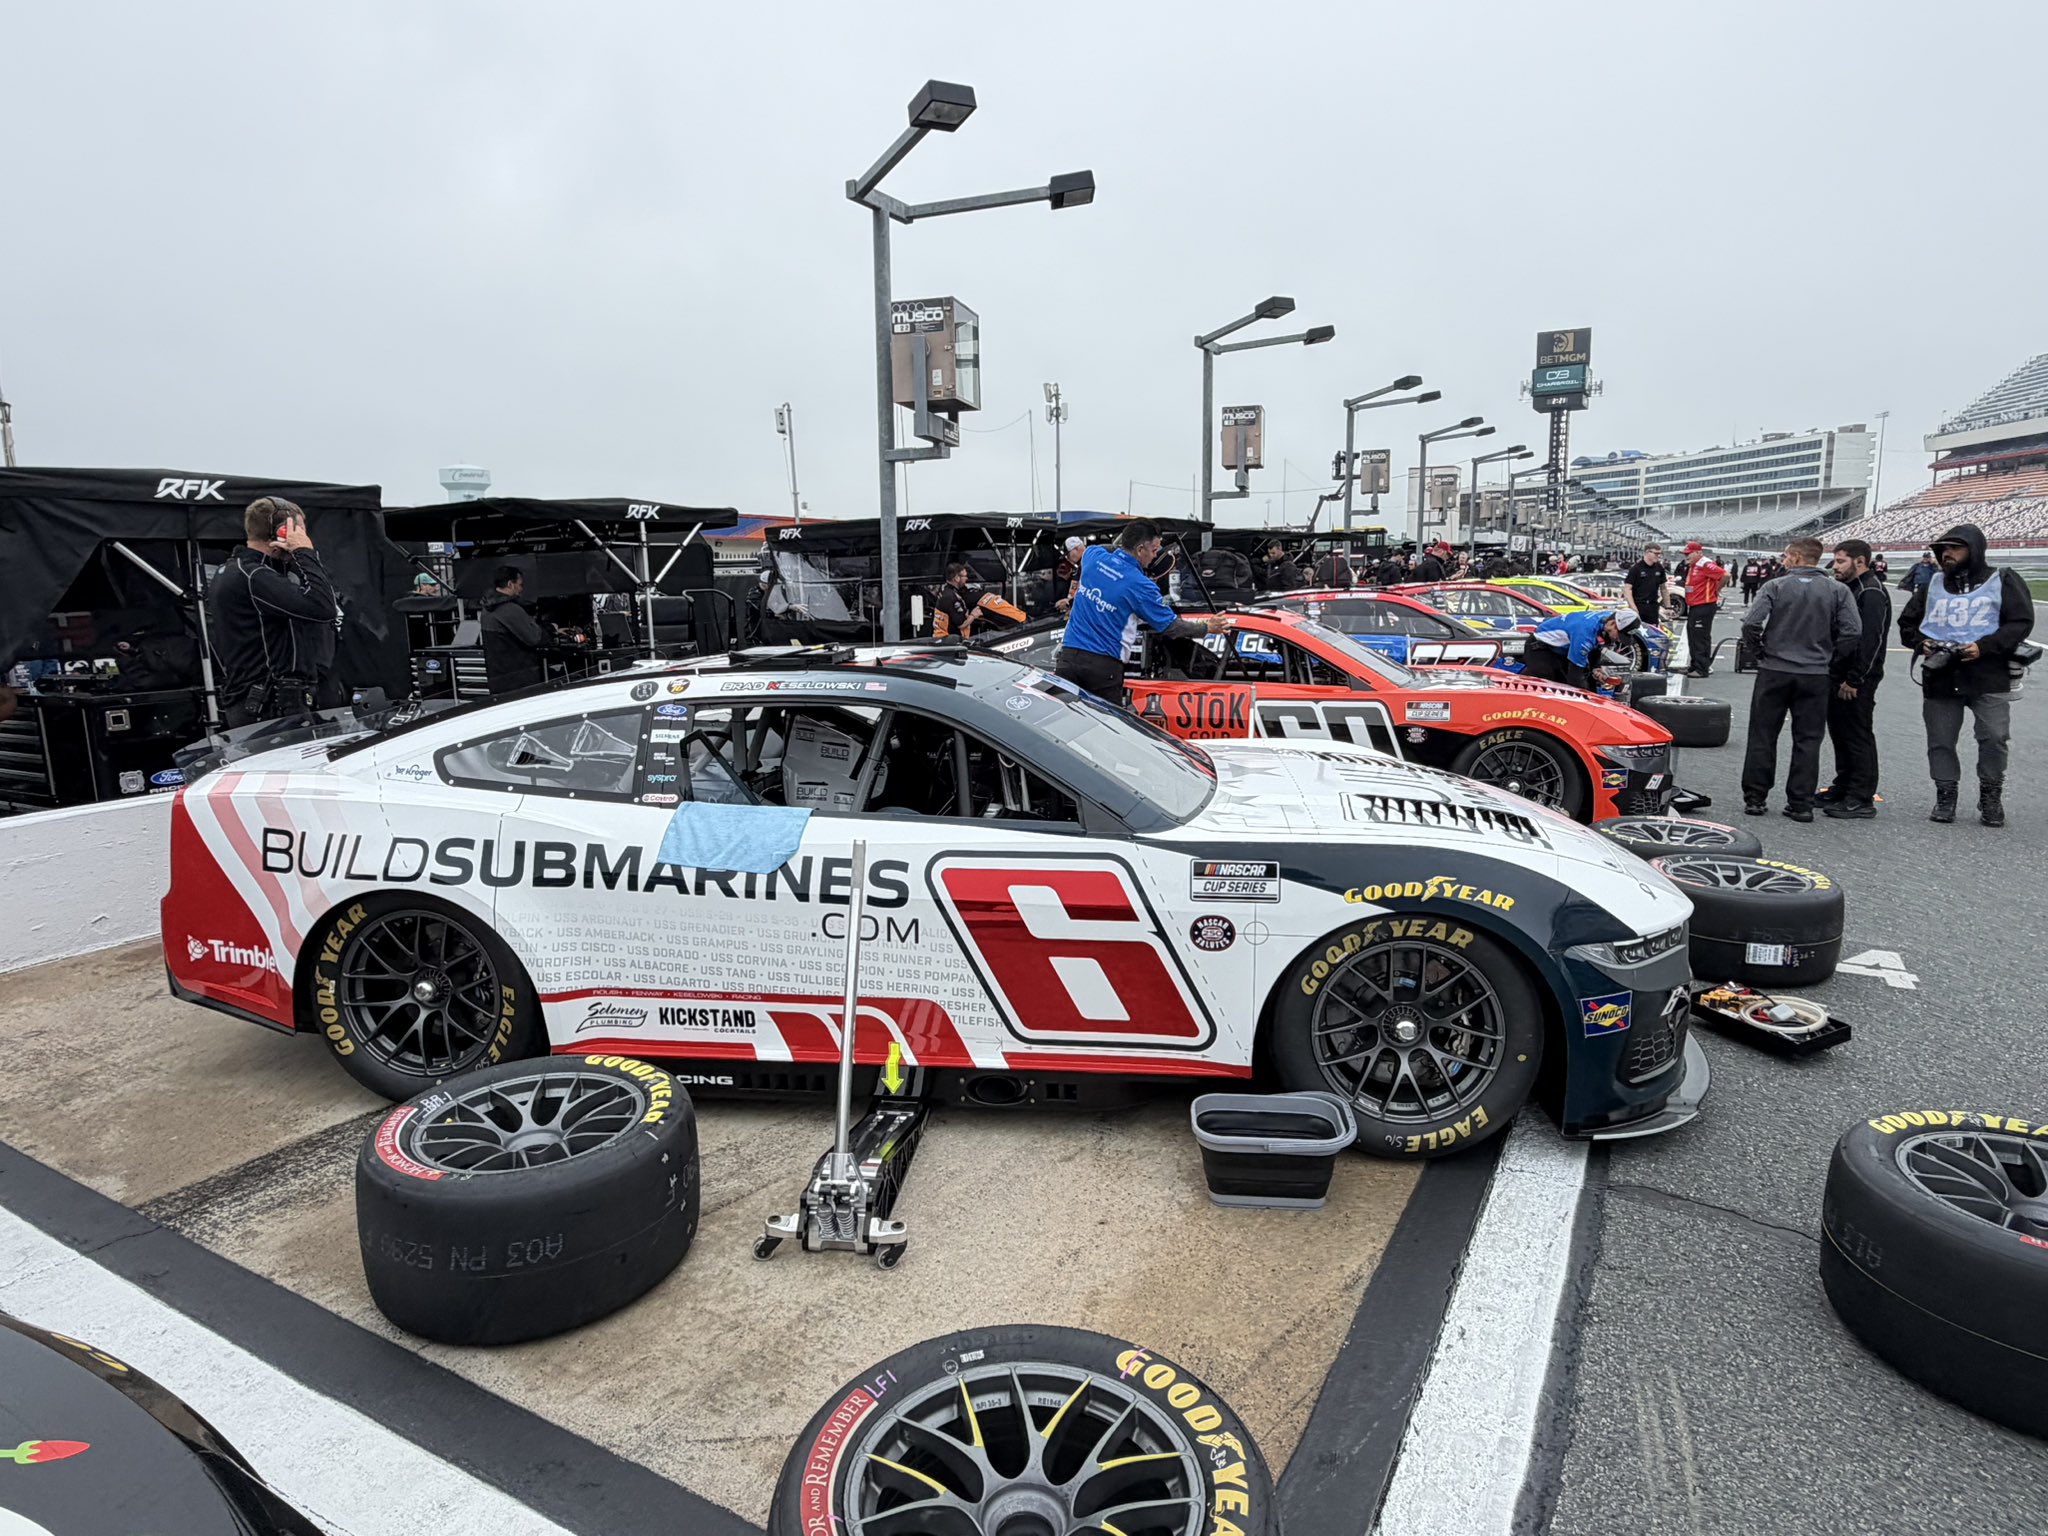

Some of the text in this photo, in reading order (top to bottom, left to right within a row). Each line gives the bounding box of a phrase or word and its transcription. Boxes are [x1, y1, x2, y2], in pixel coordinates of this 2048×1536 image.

[892, 310, 943, 323] musco
[1540, 353, 1586, 365] BETMGM
[154, 478, 226, 501] RFK
[625, 504, 660, 520] RFK
[1006, 517, 1023, 528] RFK
[779, 528, 802, 540] RFK
[904, 518, 933, 531] RFK
[1928, 598, 1990, 627] 432
[721, 680, 863, 692] BRAD KESELOWSKI
[1481, 707, 1567, 726] GOODYEAR
[1478, 730, 1524, 751] EAGLE
[405, 764, 432, 781] Kroger
[647, 774, 678, 784] syspro
[650, 795, 676, 803] Castrol
[262, 827, 909, 909] BUILDSUBMARINES
[1219, 864, 1266, 876] NASCAR
[1203, 881, 1267, 892] CUP SERIES
[1343, 876, 1516, 912] GOODYEAR
[746, 914, 768, 924] USS
[811, 912, 919, 945] .COM
[1197, 919, 1228, 930] NASCAR
[554, 913, 578, 923] USS
[582, 914, 643, 927] ARGONAUT
[654, 920, 676, 930] USS
[680, 922, 745, 936] GRENADIER
[757, 928, 780, 939] USS
[930, 943, 953, 953] USS
[1196, 938, 1229, 949] SALUTES
[207, 939, 277, 974] Trimble
[502, 928, 543, 938] YBACK
[557, 928, 581, 938] USS
[585, 928, 655, 942] AMBERJACK
[667, 935, 689, 945] USS
[693, 937, 748, 950] GRAMPUS
[760, 943, 783, 953] USS
[787, 945, 844, 958] GRAYLING
[883, 953, 932, 966] RUNNER
[944, 959, 967, 969] USS
[926, 851, 1215, 1050] 6
[1300, 918, 1475, 996] GOODYEAR
[552, 942, 577, 952] USS
[581, 942, 615, 953] CISCO
[627, 946, 649, 956] USS
[653, 948, 699, 960] DORADO
[711, 953, 733, 963] USS
[737, 955, 788, 968] CORVINA
[799, 961, 822, 971] USS
[826, 963, 885, 976] SCOPION
[897, 968, 920, 979] USS
[315, 903, 367, 1056] GOODYEAR
[525, 956, 591, 968] WORDFISH
[604, 958, 626, 968] USS
[630, 960, 689, 973] ALBACORE
[700, 966, 722, 976] USS
[726, 968, 756, 979] TANG
[768, 972, 790, 982] USS
[860, 980, 883, 990] USS
[887, 982, 939, 994] HERRING
[952, 988, 975, 998] USS
[537, 973, 561, 982] USS
[566, 971, 621, 982] ESCOLAR
[634, 974, 655, 983] USS
[660, 976, 710, 988] LAGARTO
[722, 982, 744, 991] USS
[936, 1000, 986, 1012] RESHER
[1585, 1003, 1630, 1024] SUNOCO
[488, 984, 516, 1064] EAGLE
[659, 1007, 756, 1028] KICKSTAND
[951, 1014, 1003, 1027] TILEFISH
[677, 1075, 734, 1086] CING
[1404, 1105, 1489, 1152] EAGLE
[450, 1246, 487, 1272] PN
[805, 1395, 868, 1486] REMEMBER
[811, 1488, 821, 1511] AND
